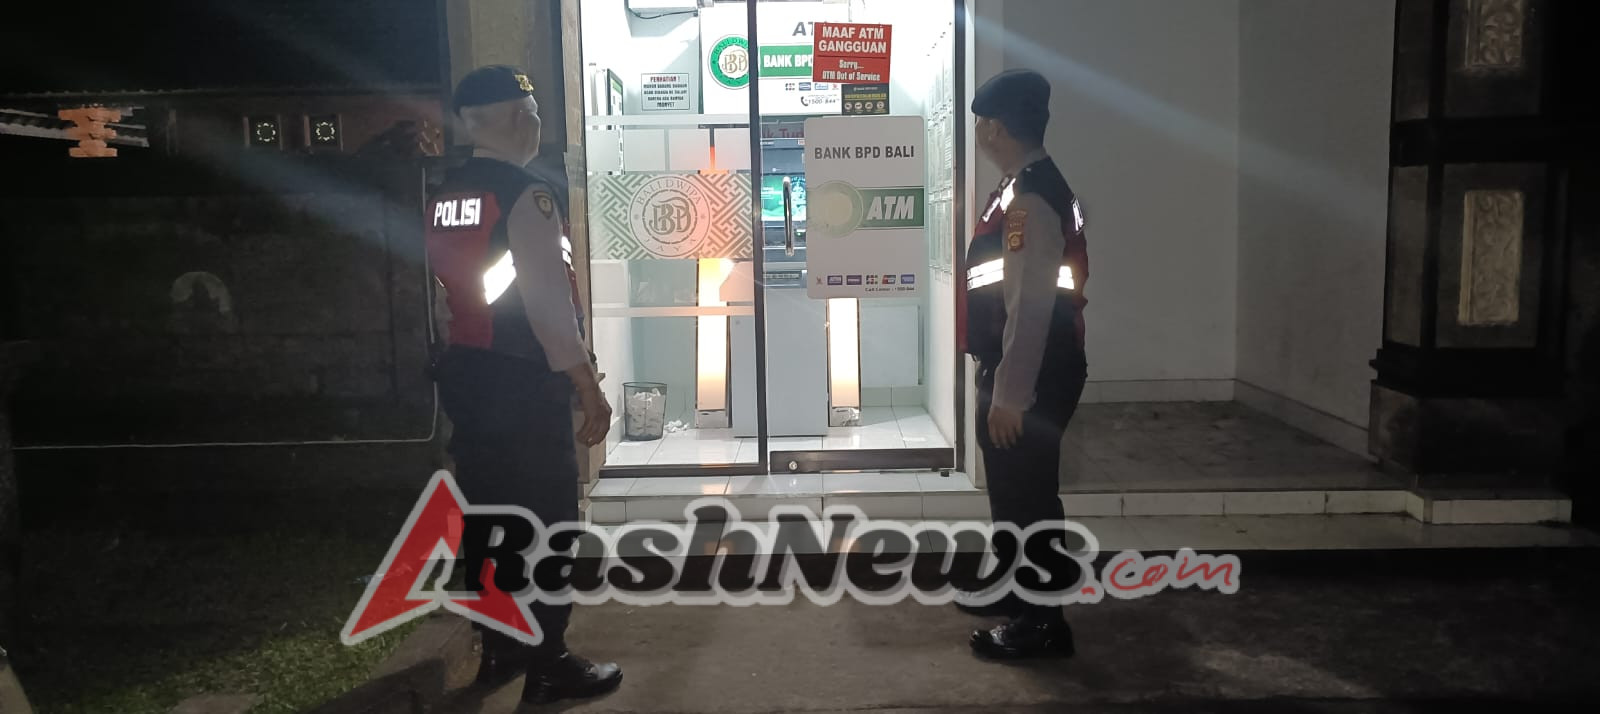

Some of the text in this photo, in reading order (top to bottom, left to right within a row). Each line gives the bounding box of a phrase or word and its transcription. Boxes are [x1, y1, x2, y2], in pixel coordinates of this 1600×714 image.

[823, 26, 884, 39] MAAF ATM
[819, 40, 886, 53] GANGGUAN
[763, 54, 792, 67] BANK
[837, 71, 847, 80] Out
[849, 72, 855, 80] of
[857, 72, 880, 81] Service
[814, 145, 914, 159] BANK BPD BALI
[434, 198, 481, 227] POLISI
[866, 195, 915, 220] ATM
